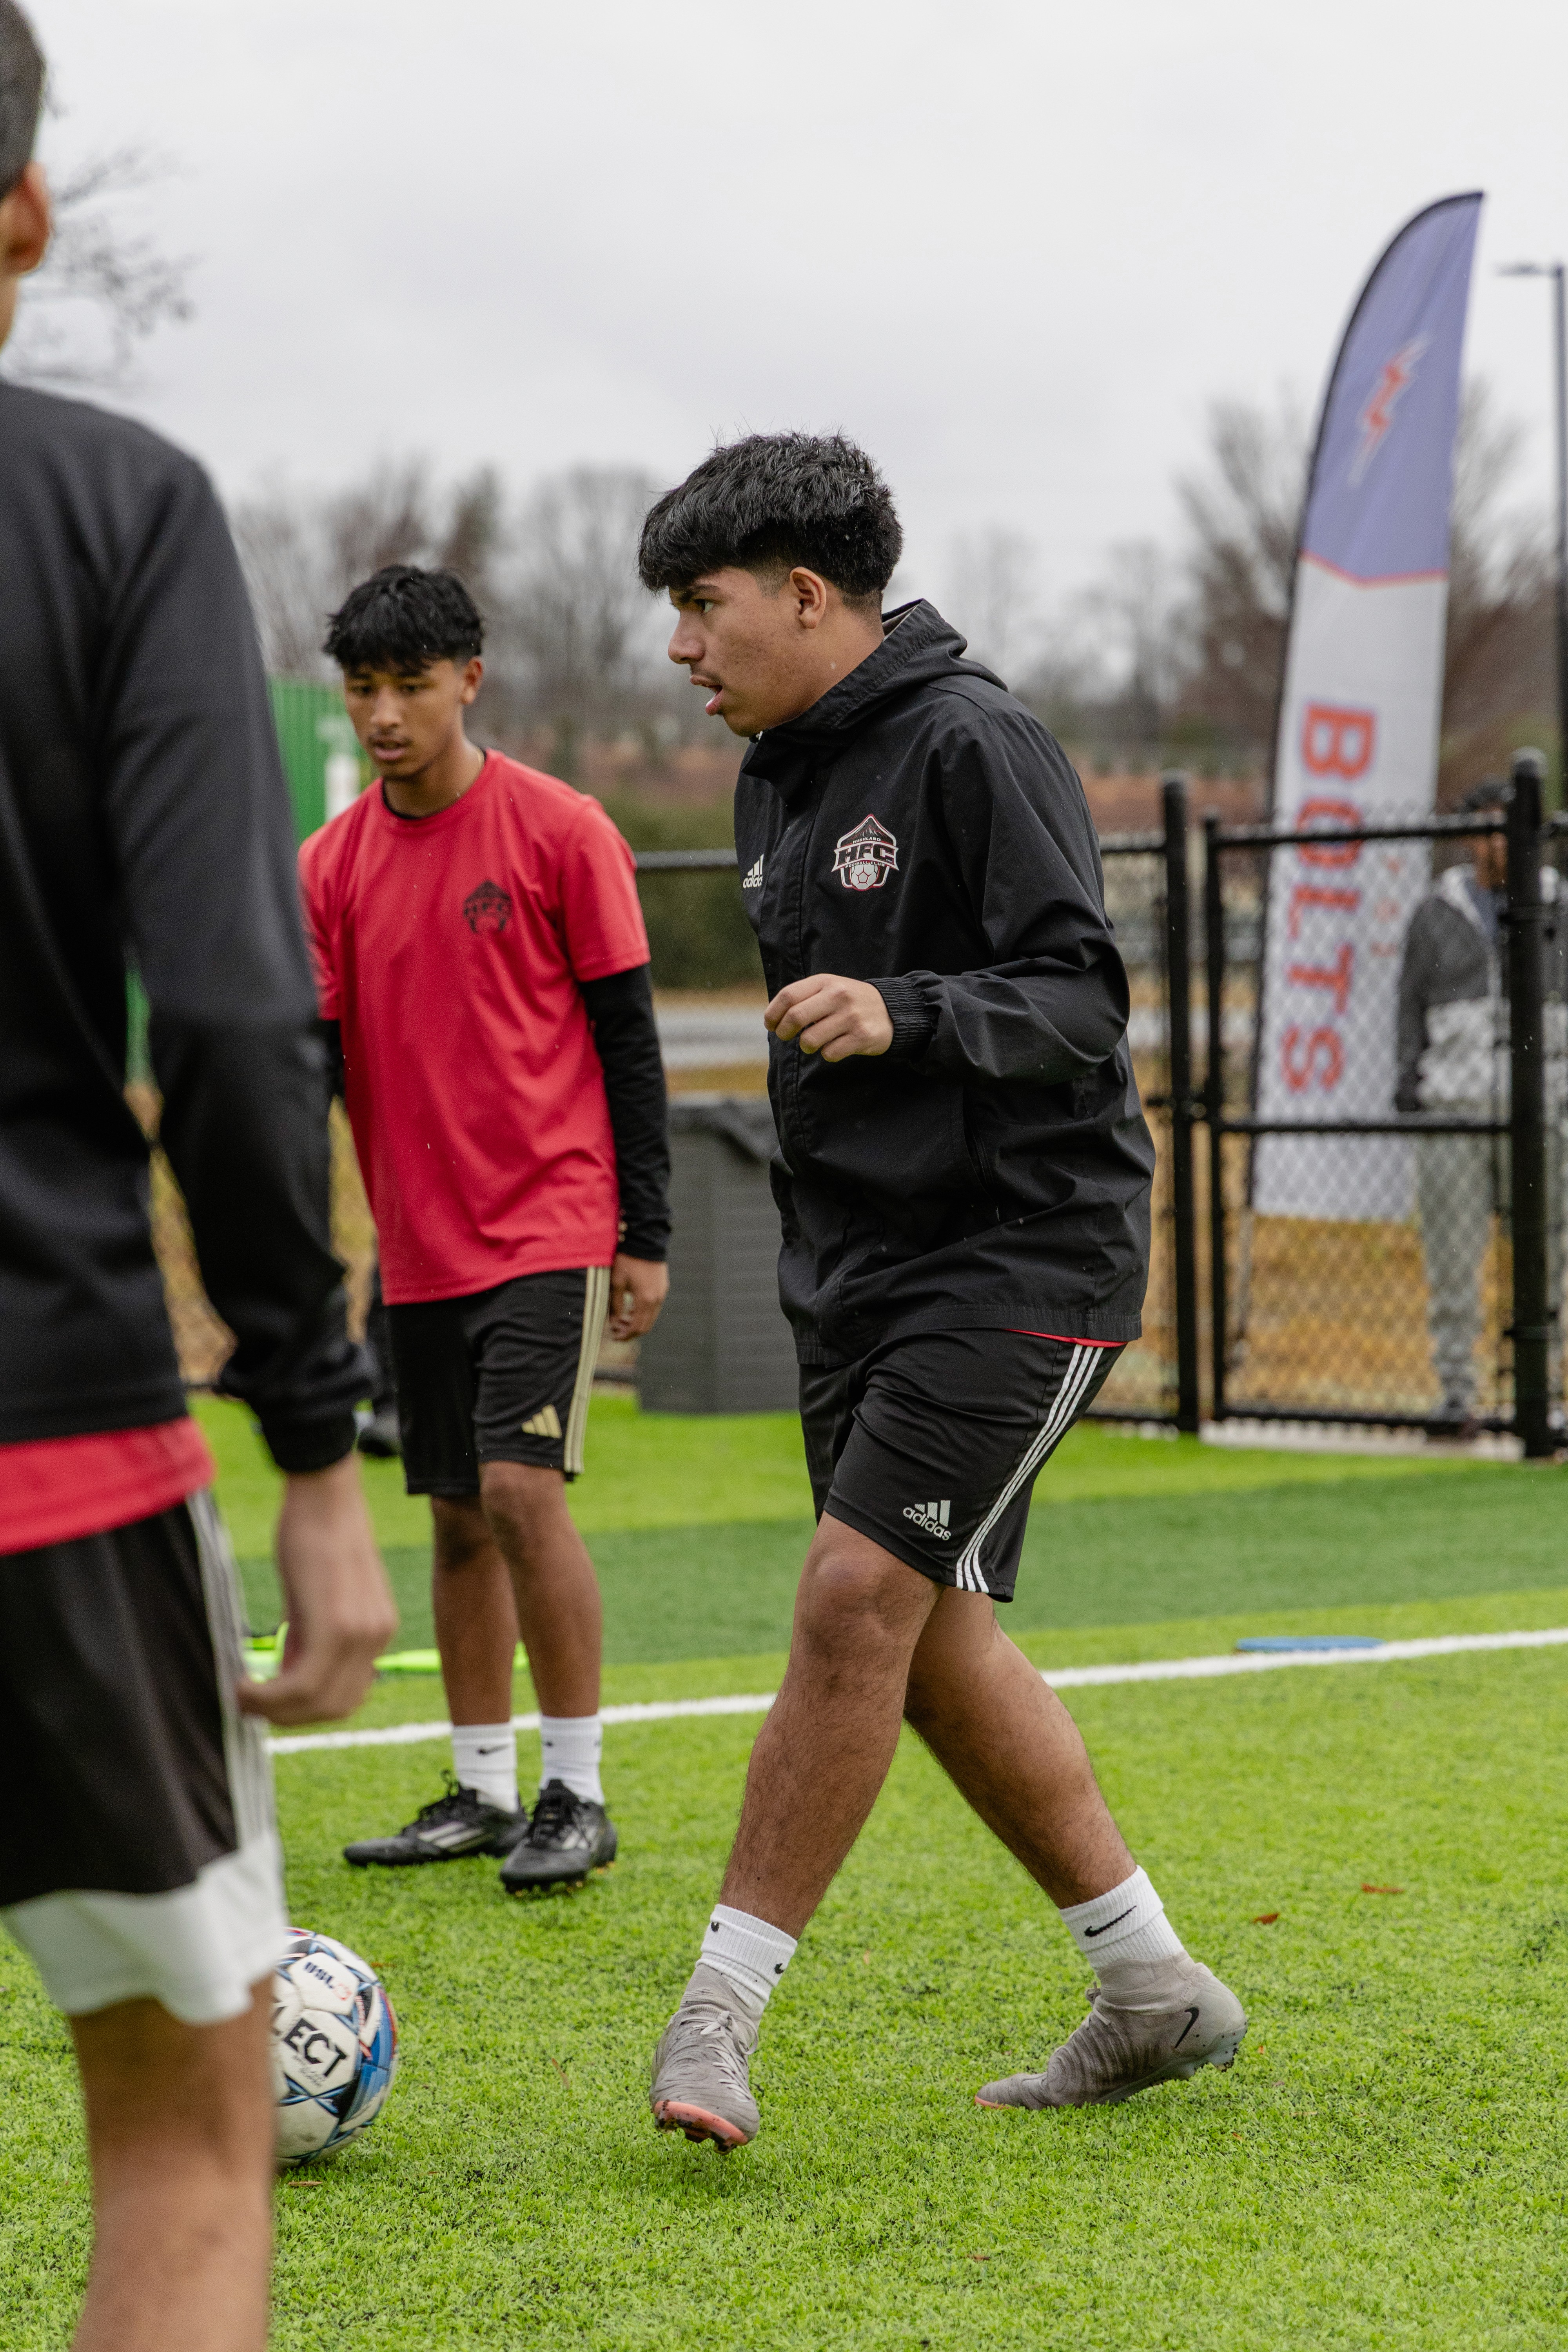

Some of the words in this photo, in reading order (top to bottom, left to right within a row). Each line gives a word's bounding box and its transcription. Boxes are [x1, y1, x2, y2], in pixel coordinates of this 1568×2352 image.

[837, 843, 895, 866] HFC
[1282, 702, 1376, 1093] BOLTS
[903, 1507, 951, 1541] adidas
